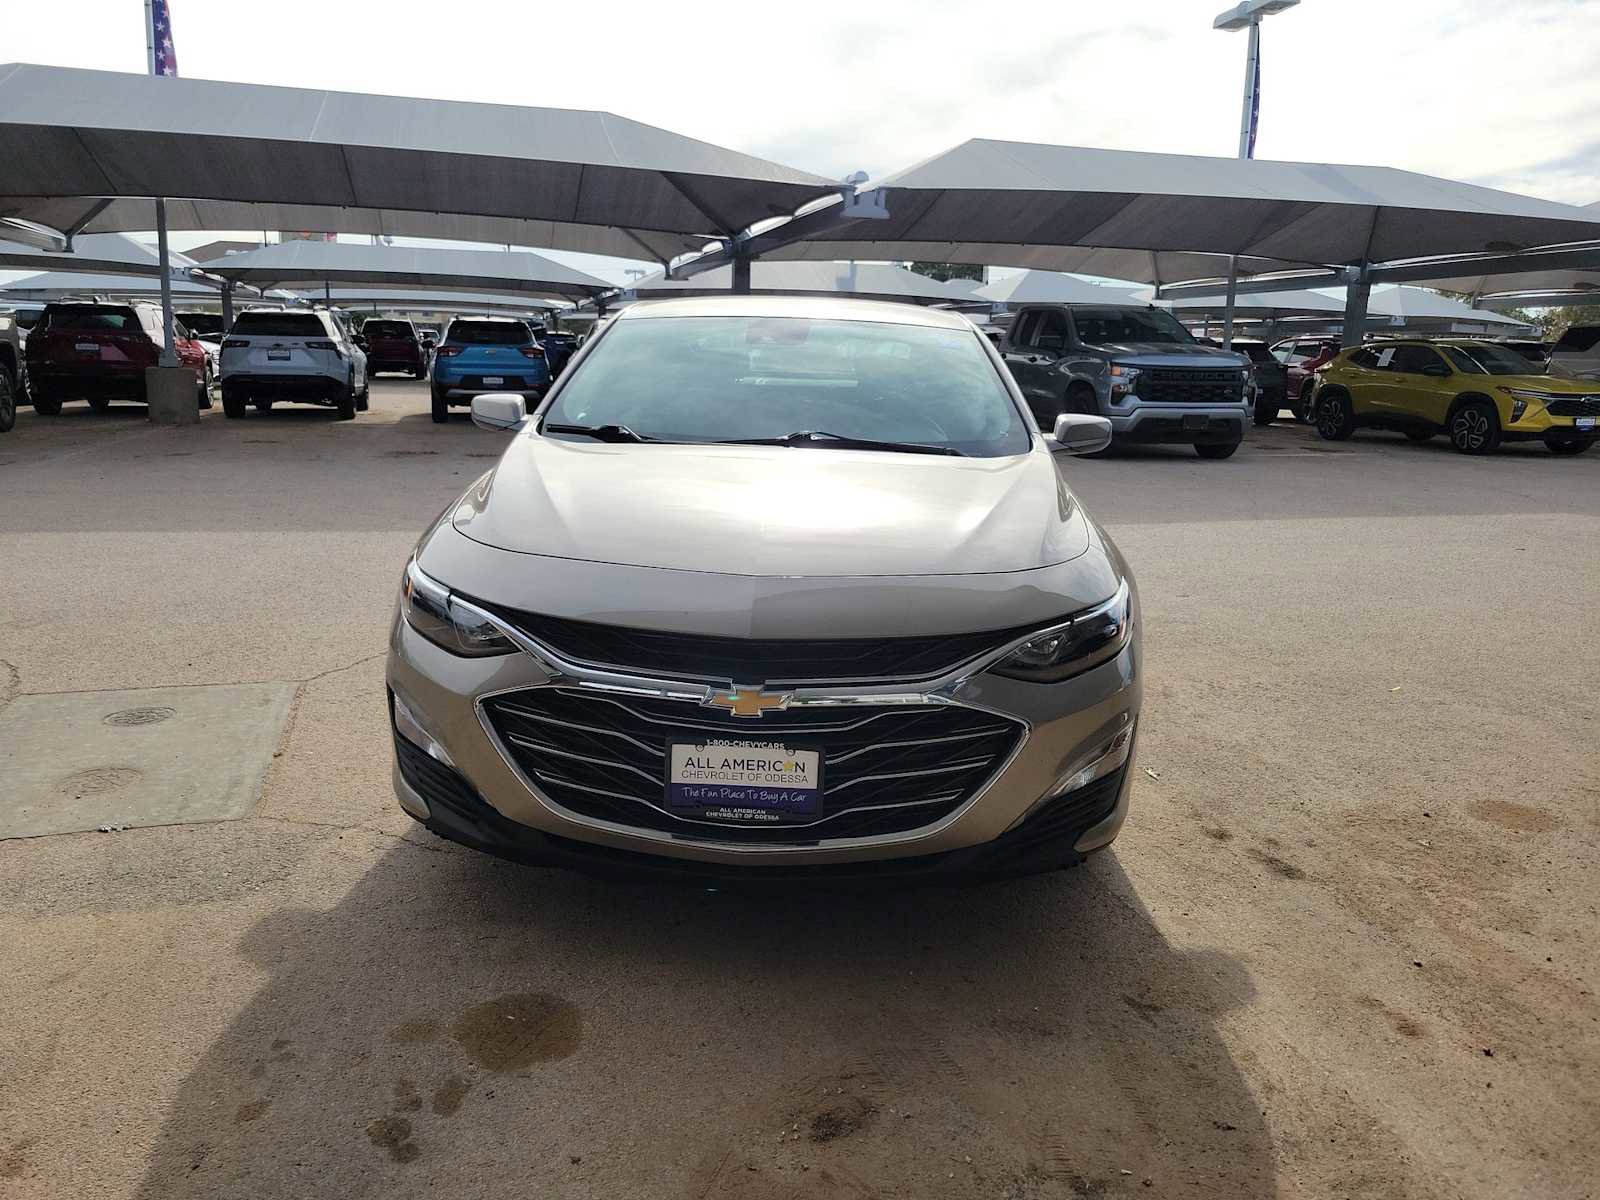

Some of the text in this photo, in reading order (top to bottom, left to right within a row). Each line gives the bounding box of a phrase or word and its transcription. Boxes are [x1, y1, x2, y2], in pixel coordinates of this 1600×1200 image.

[685, 757, 805, 773] ALL AMERICN
[681, 770, 808, 784] CHEVROLET OF ODESSA
[682, 787, 807, 803] The Fun Place To Buy A Car
